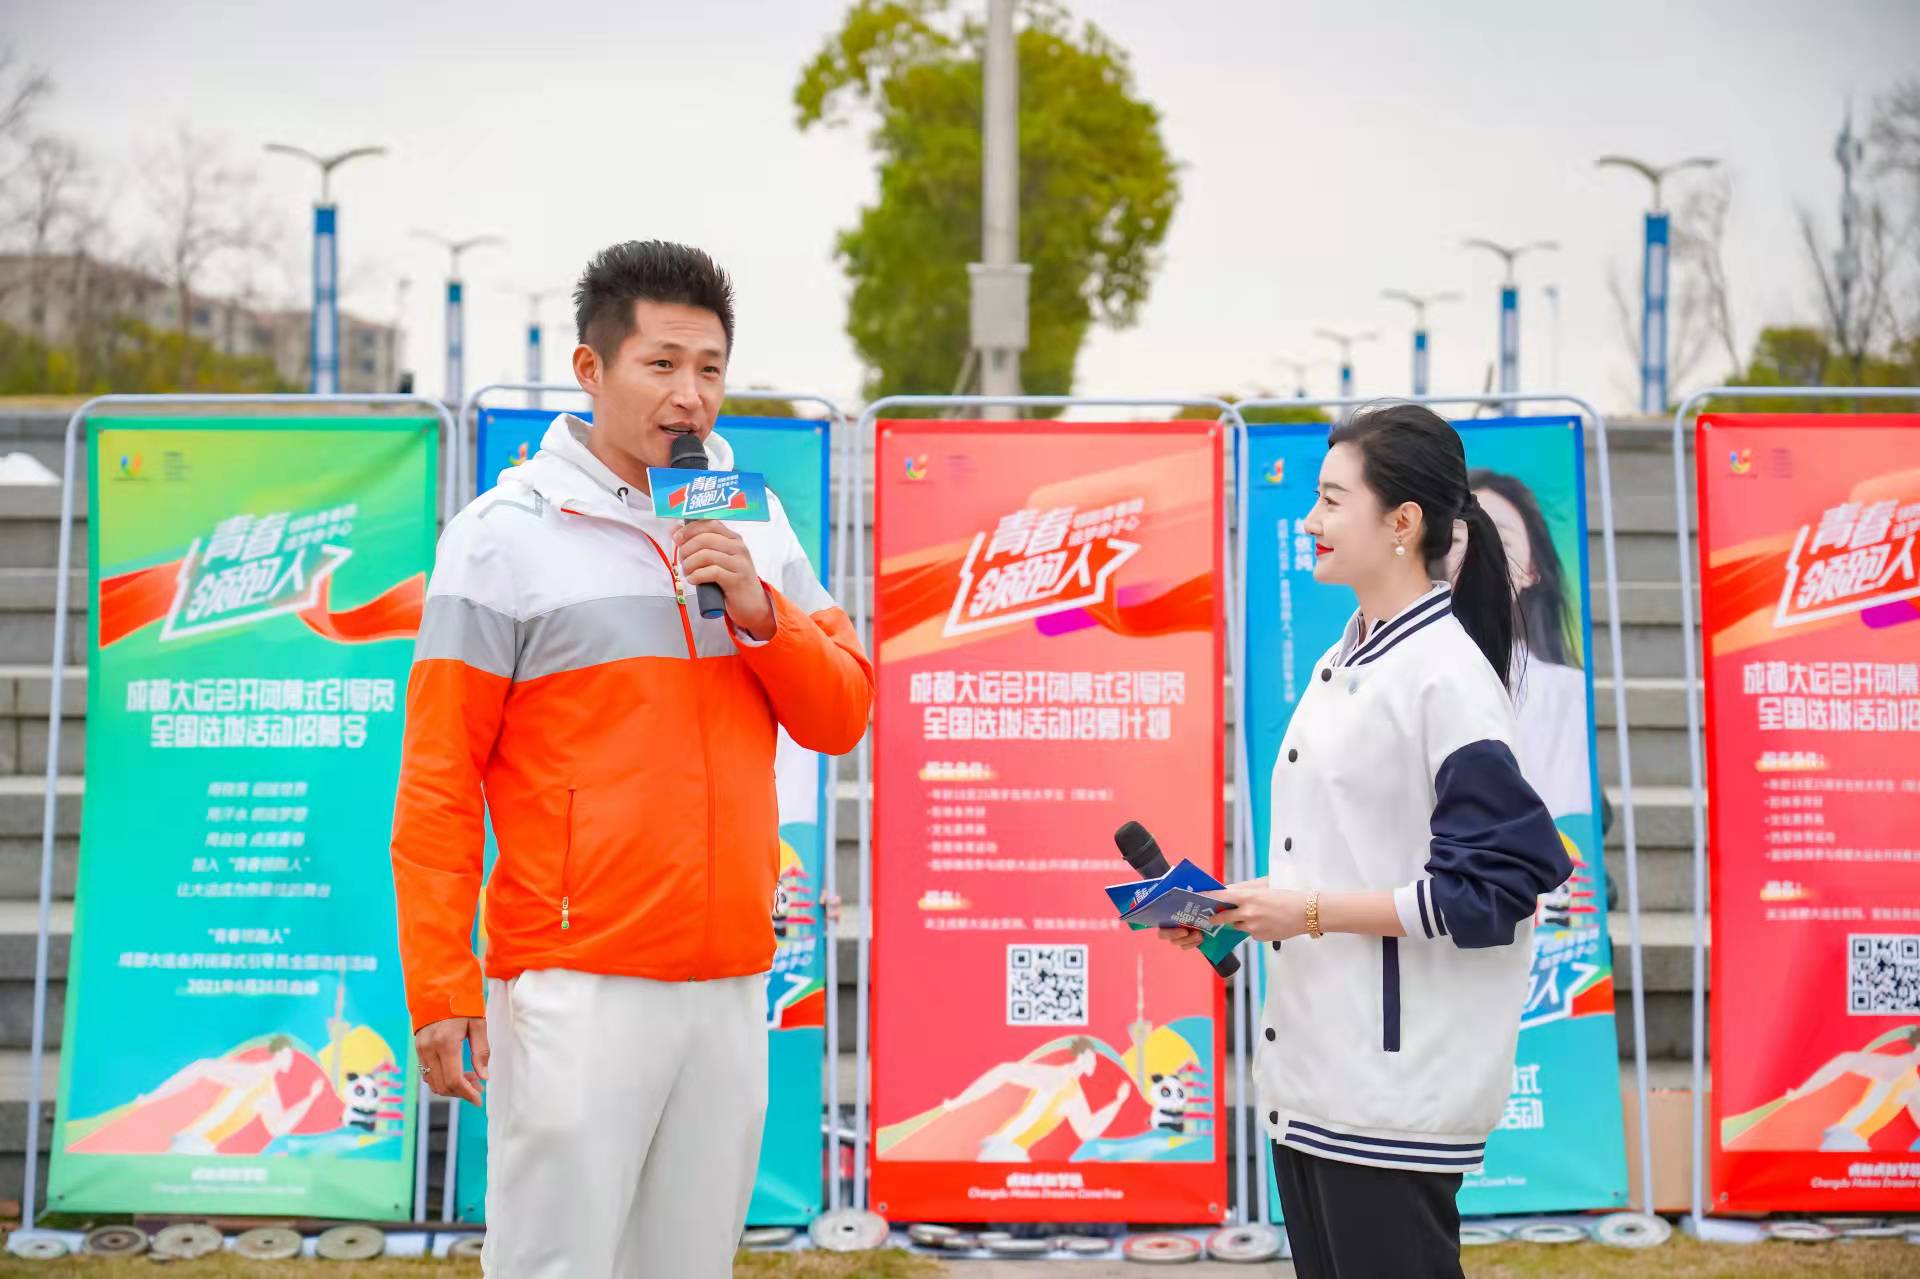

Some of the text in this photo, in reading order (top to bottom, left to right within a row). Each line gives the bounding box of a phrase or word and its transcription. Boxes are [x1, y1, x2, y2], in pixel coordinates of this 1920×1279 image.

[690, 489, 726, 509] 领跑人
[691, 475, 718, 492] 青春
[203, 514, 290, 564] 青春
[986, 506, 1076, 560] 青春
[1810, 500, 1898, 554] 青春
[189, 550, 304, 620] 领跑人
[971, 544, 1091, 616] 领跑人
[1798, 535, 1914, 607] 领跑人
[1512, 1064, 1541, 1094] 式
